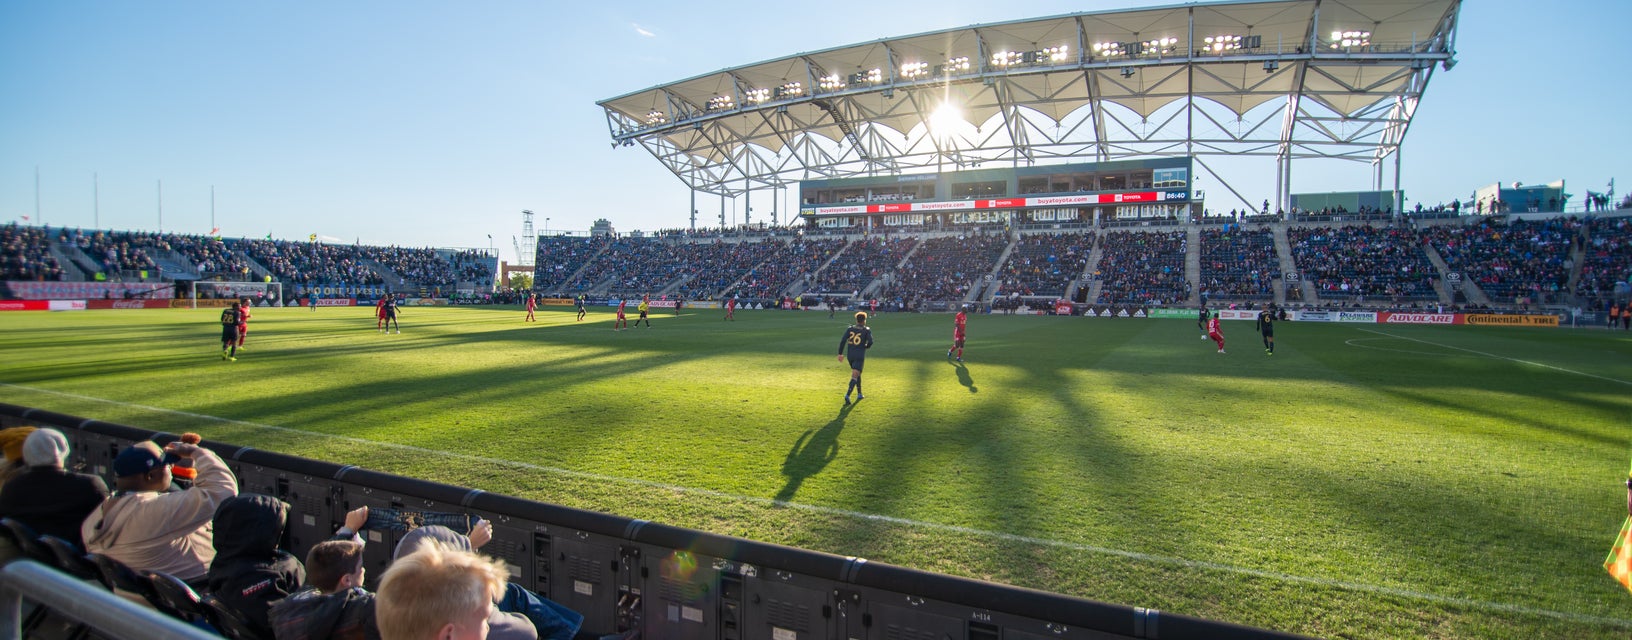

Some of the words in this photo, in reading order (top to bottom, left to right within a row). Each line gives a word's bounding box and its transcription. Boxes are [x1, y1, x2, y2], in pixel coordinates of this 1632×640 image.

[1037, 196, 1088, 204] buyatoyota.com
[346, 287, 372, 295] LIKES
[112, 301, 145, 309] Coca-Cola
[1264, 315, 1271, 324] 6
[1388, 314, 1453, 323] ADVOCARE
[1467, 315, 1522, 324] Continental
[848, 331, 861, 345] 26
